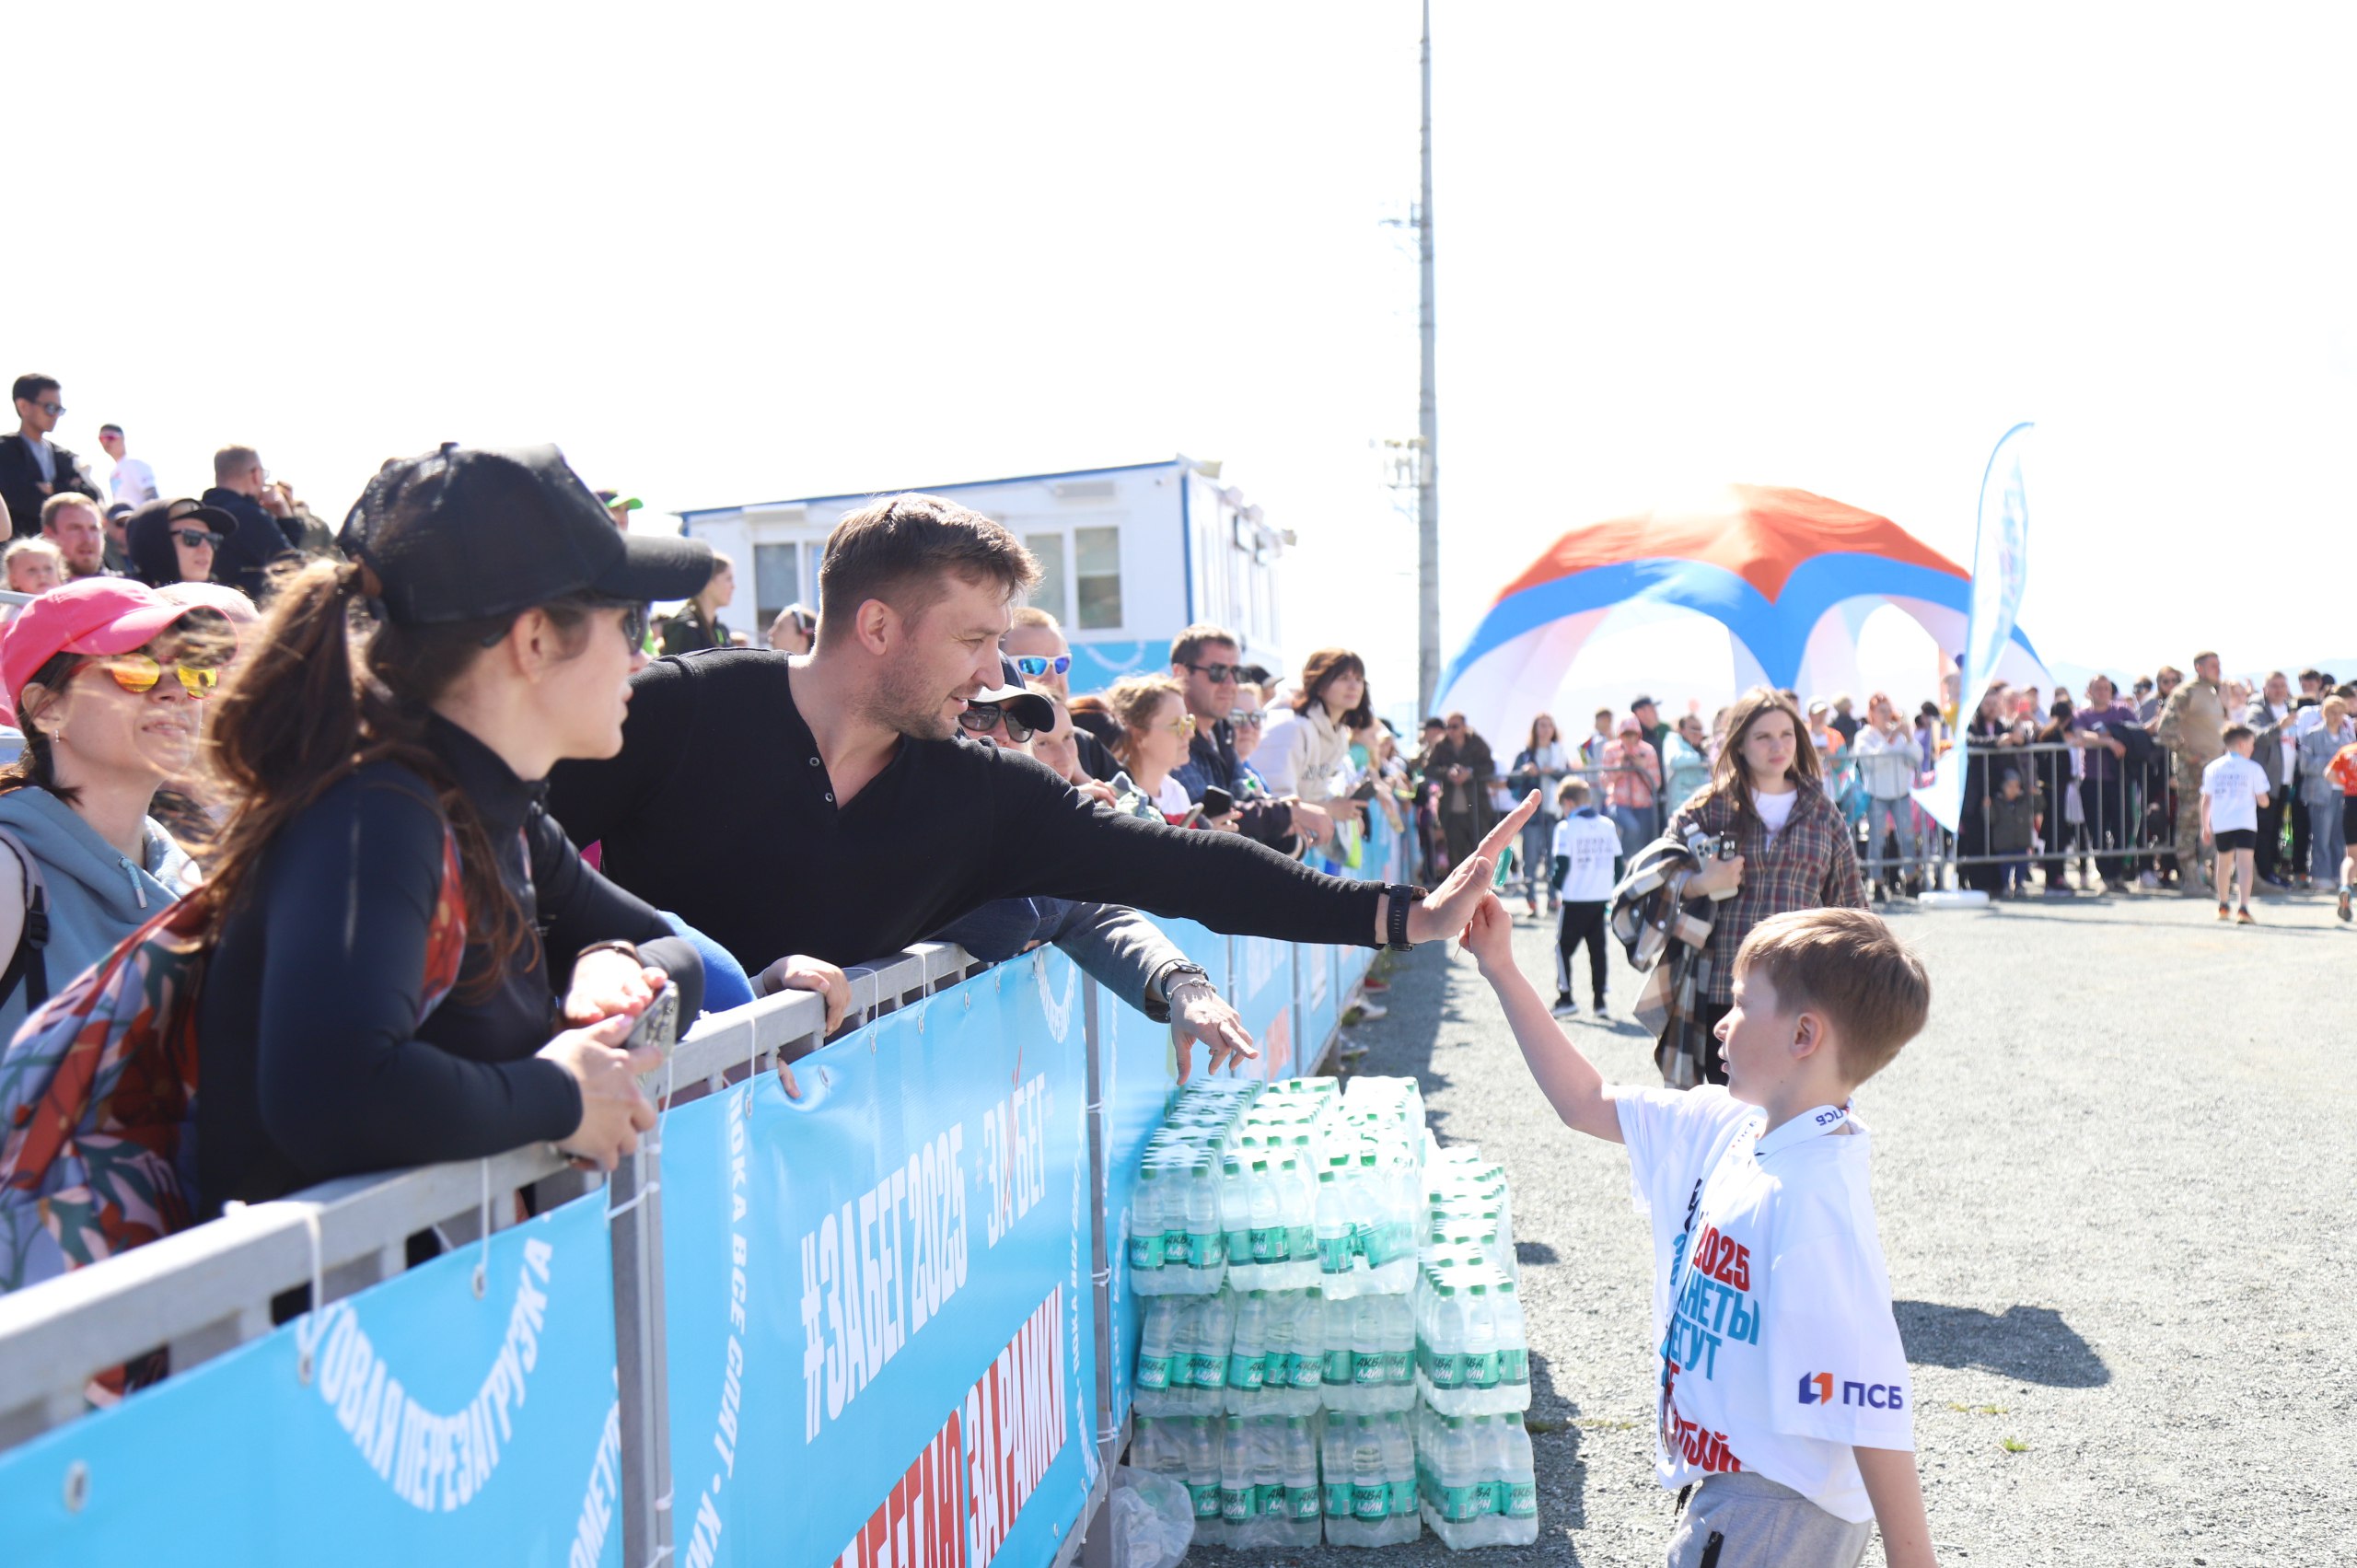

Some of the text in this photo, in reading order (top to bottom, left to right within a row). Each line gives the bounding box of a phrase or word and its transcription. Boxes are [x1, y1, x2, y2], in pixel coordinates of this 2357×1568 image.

[730, 1086, 747, 1224] ПОКА
[730, 1232, 747, 1335] ВСЕ
[1681, 1271, 1760, 1346] НЕТЫ
[713, 1335, 744, 1480] СПЯТ
[998, 1281, 1067, 1540] РАМКИ
[1843, 1381, 1904, 1410] ПСБ
